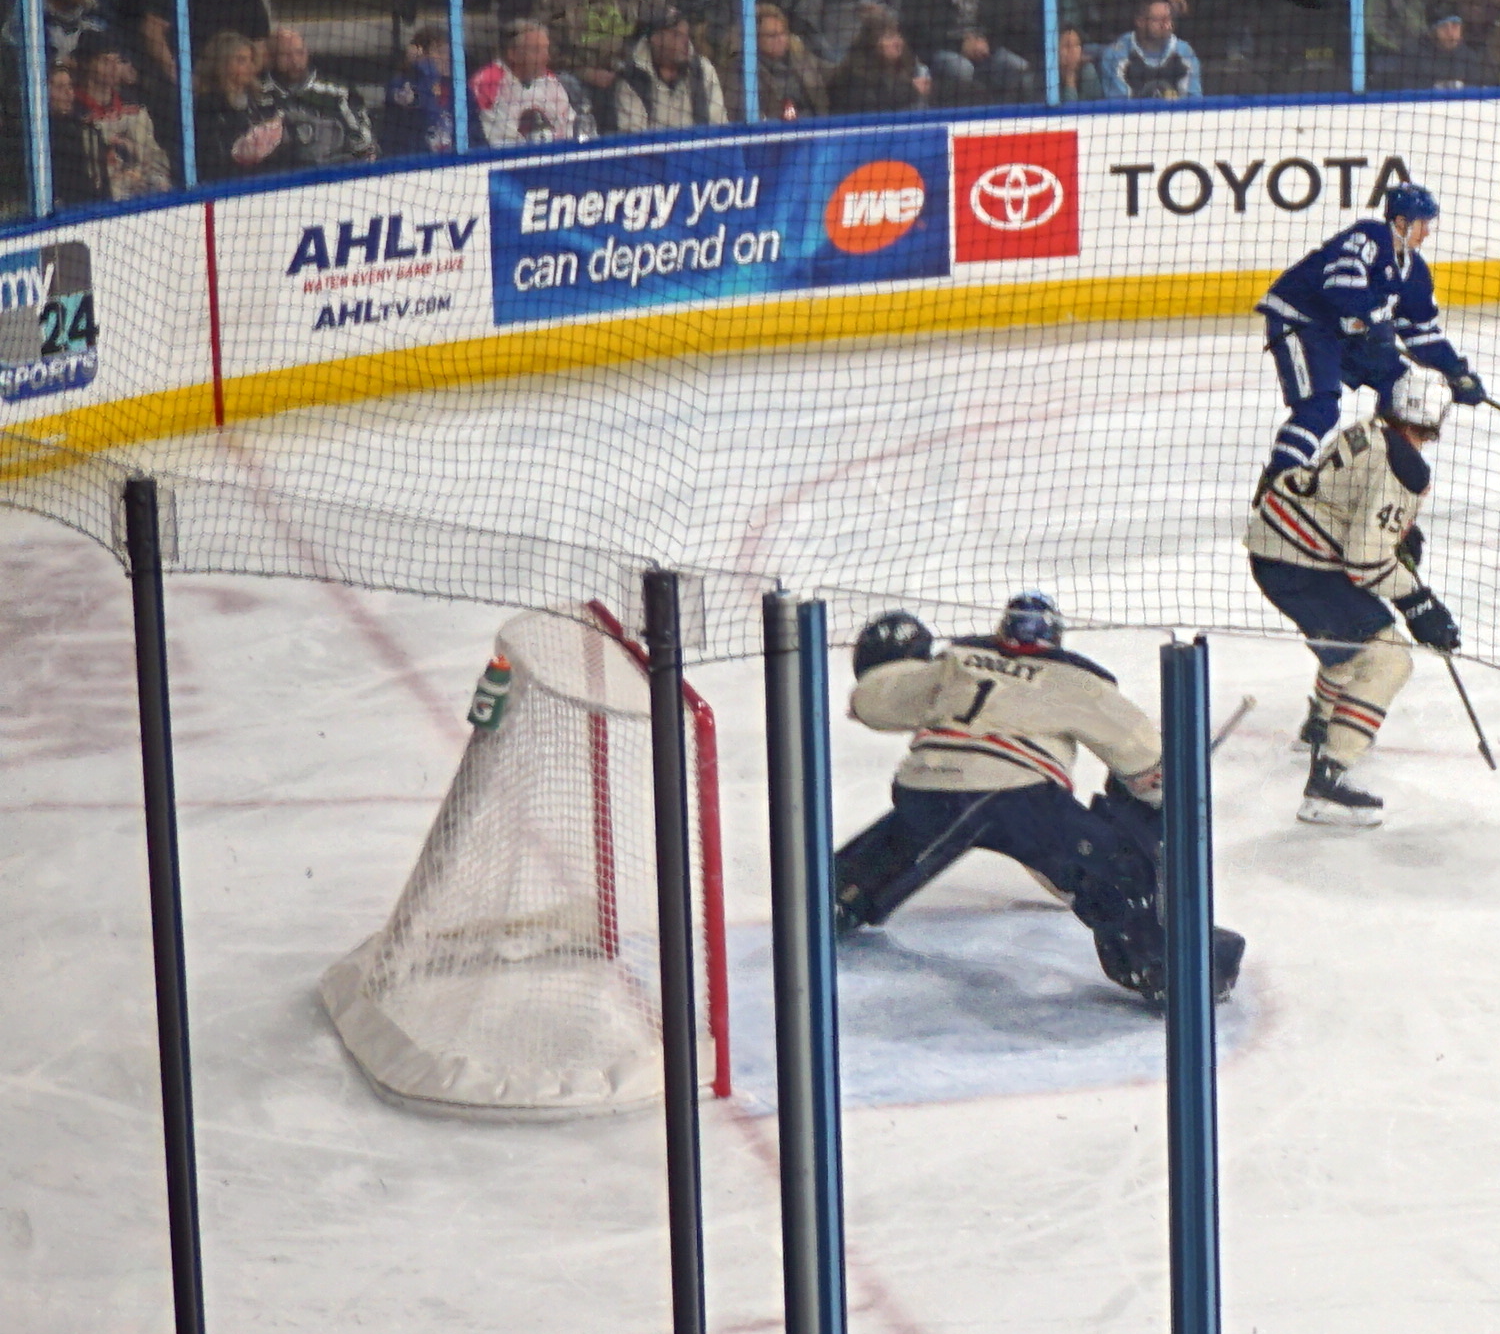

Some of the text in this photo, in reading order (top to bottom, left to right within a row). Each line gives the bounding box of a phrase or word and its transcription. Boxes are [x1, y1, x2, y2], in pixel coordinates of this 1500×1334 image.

[520, 175, 760, 234] Energy you
[841, 186, 925, 229] we
[1109, 155, 1411, 217] TOYOTA
[513, 224, 781, 292] can depend on
[39, 290, 100, 358] 24
[315, 293, 452, 332] AHLTV.COM
[952, 679, 997, 726] 1
